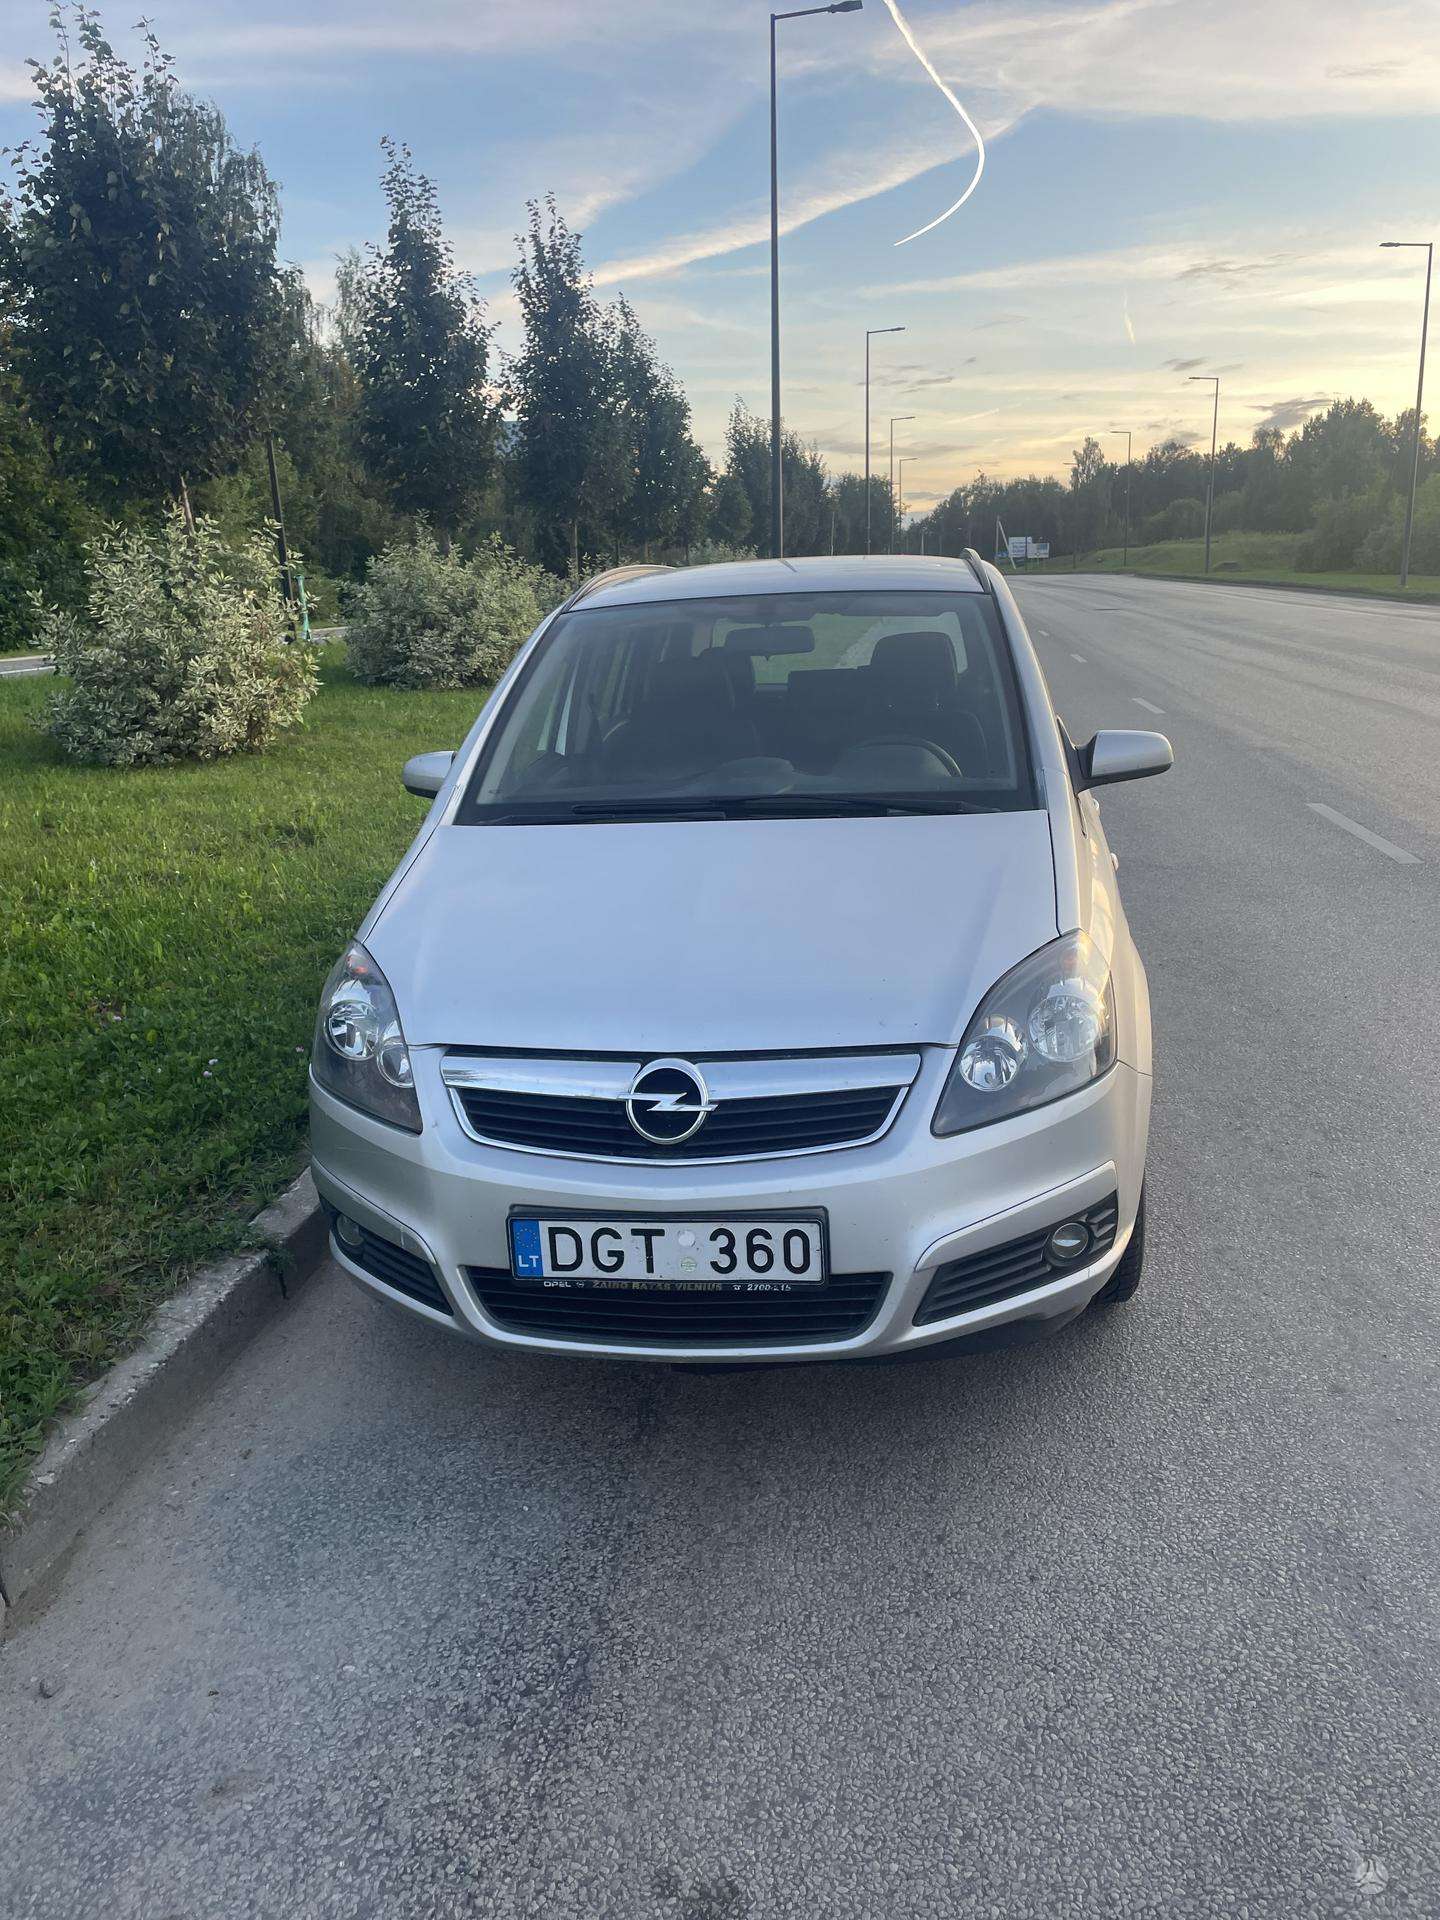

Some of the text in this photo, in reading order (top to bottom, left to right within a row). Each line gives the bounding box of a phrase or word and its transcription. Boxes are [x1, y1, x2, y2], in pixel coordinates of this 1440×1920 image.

[518, 1255, 539, 1268] LT
[547, 1226, 811, 1275] DGT 360
